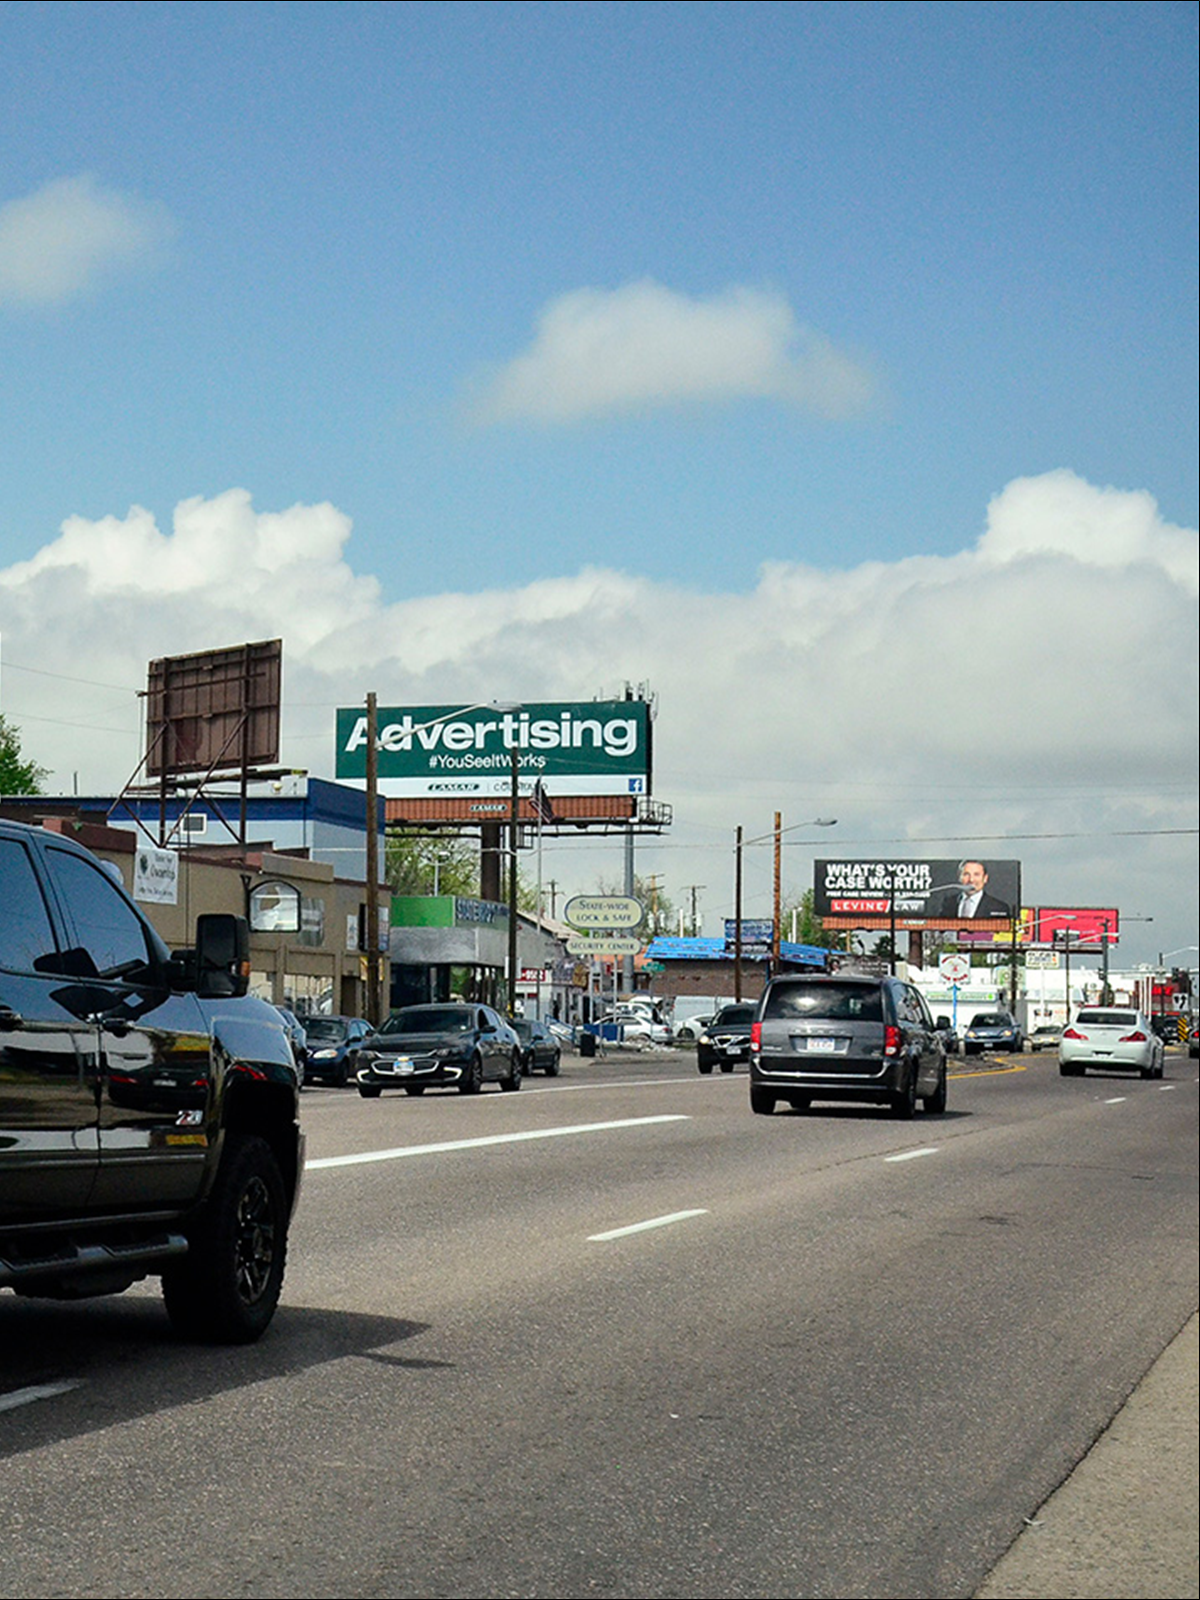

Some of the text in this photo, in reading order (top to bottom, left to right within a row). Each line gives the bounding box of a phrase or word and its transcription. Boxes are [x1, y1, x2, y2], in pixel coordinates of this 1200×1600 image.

[345, 711, 638, 757] Advertising
[827, 864, 930, 877] WHAT'S YOUR
[825, 876, 932, 889] CASE WORTH?
[834, 901, 884, 910] LEVINE
[571, 942, 604, 950] SECURITY
